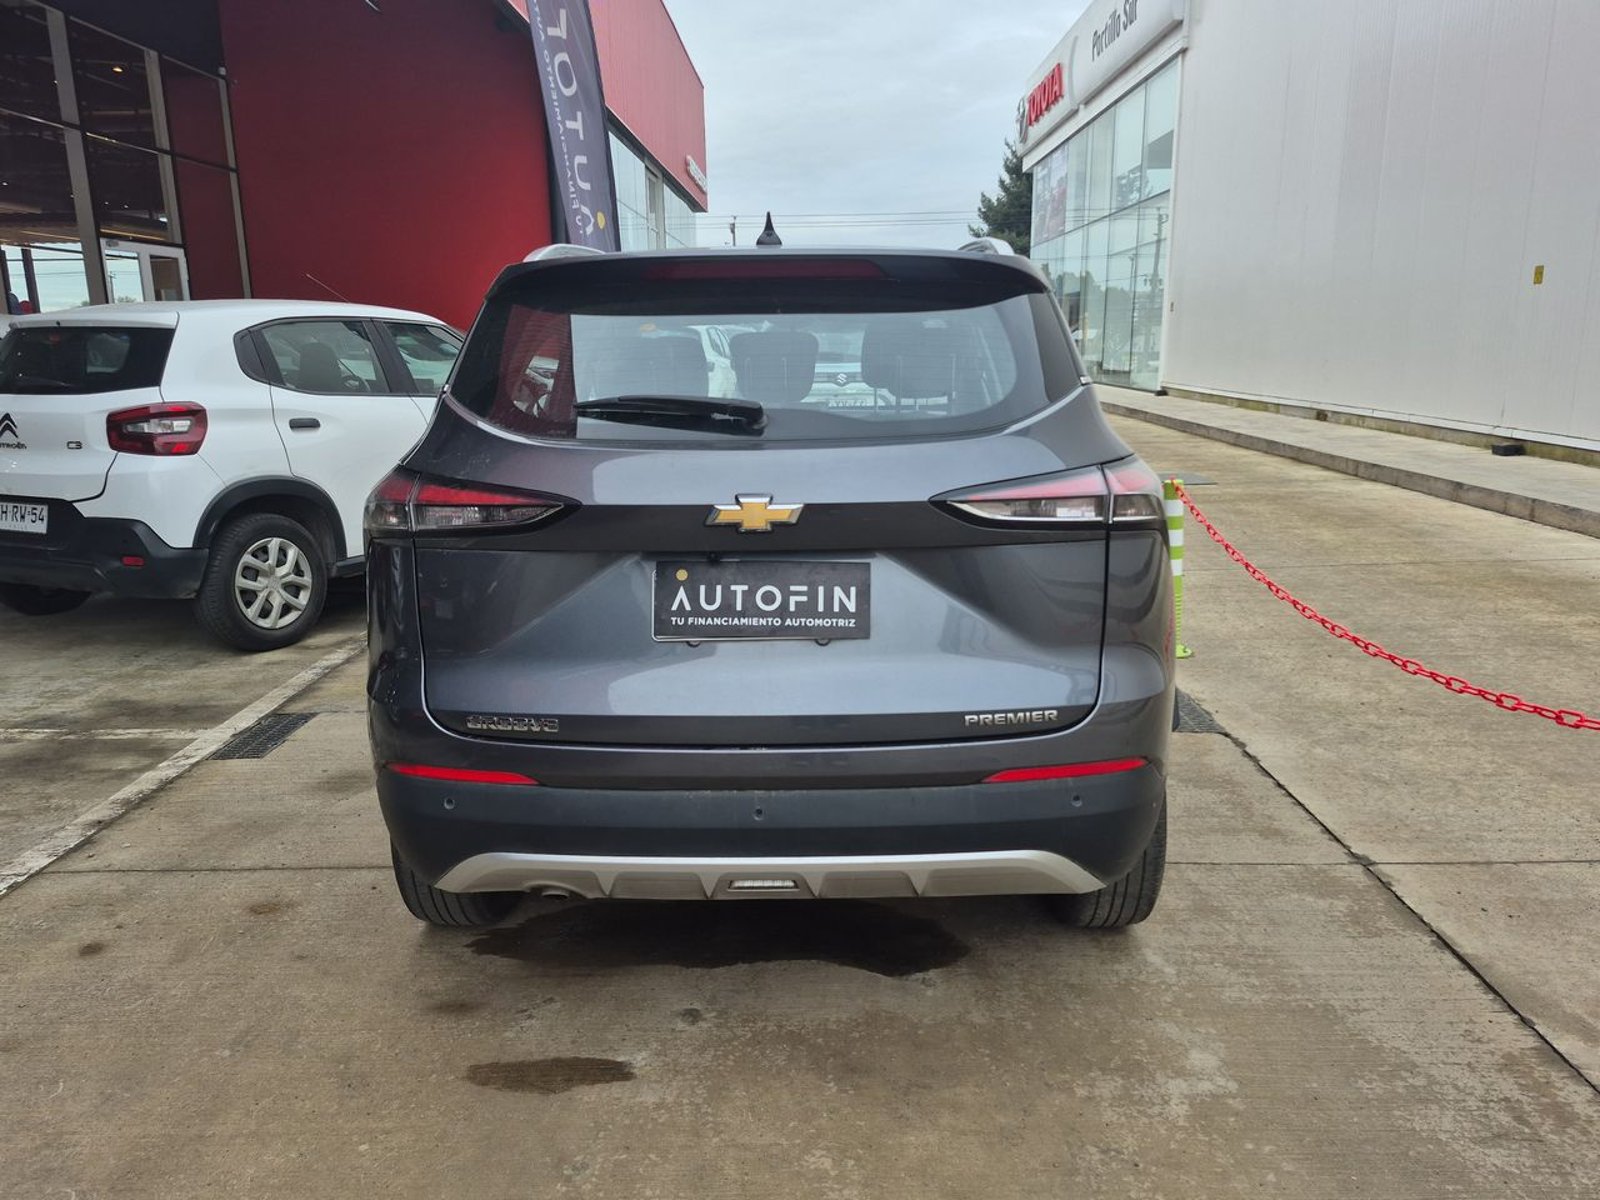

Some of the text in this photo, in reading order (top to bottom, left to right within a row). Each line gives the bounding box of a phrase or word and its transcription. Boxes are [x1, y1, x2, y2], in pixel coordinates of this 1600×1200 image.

[1091, 0, 1138, 62] Portillo Sur
[1027, 62, 1064, 127] TOYOTA
[66, 440, 83, 449] C3
[671, 584, 857, 612] AUTOFIN
[671, 617, 856, 628] TU FINANCIAMIENTO AUTOMOTRIZ
[466, 715, 559, 733] GROOVE
[964, 709, 1058, 726] PREMIER
